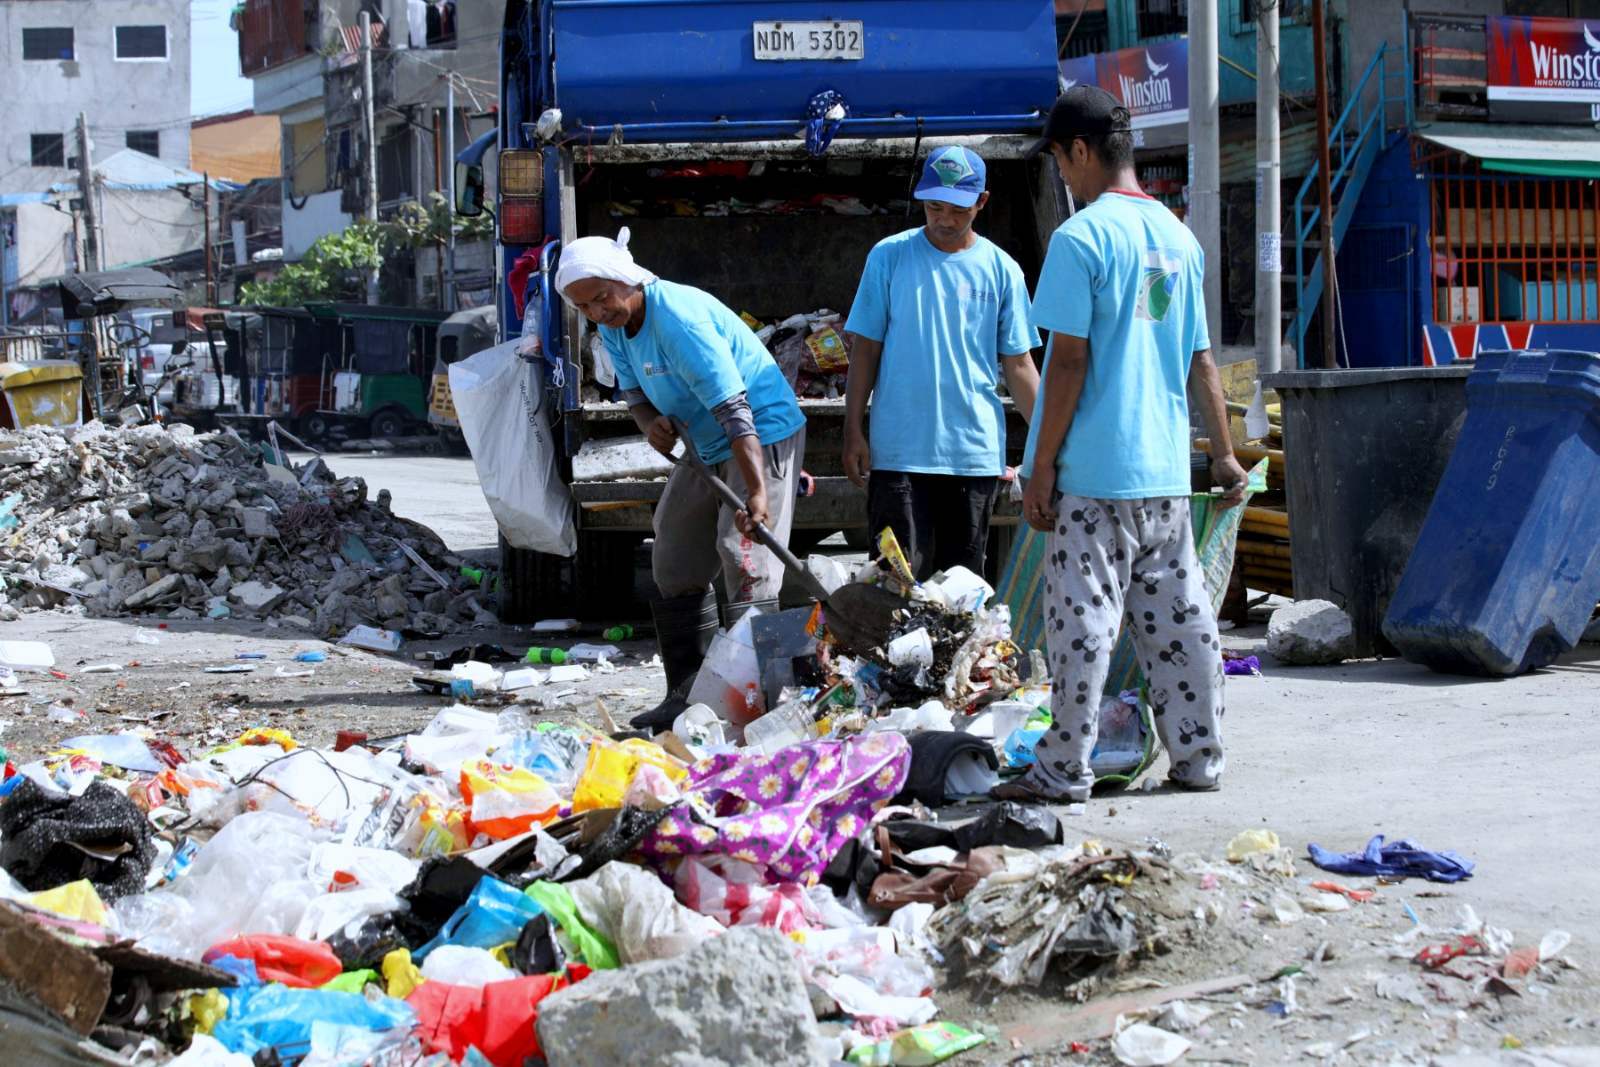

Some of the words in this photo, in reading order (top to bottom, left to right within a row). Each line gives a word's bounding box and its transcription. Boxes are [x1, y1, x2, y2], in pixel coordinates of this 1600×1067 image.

[757, 31, 795, 51] NDM
[809, 31, 859, 51] 5302
[1118, 73, 1172, 107] Winston
[1534, 80, 1580, 88] INNOVATORS
